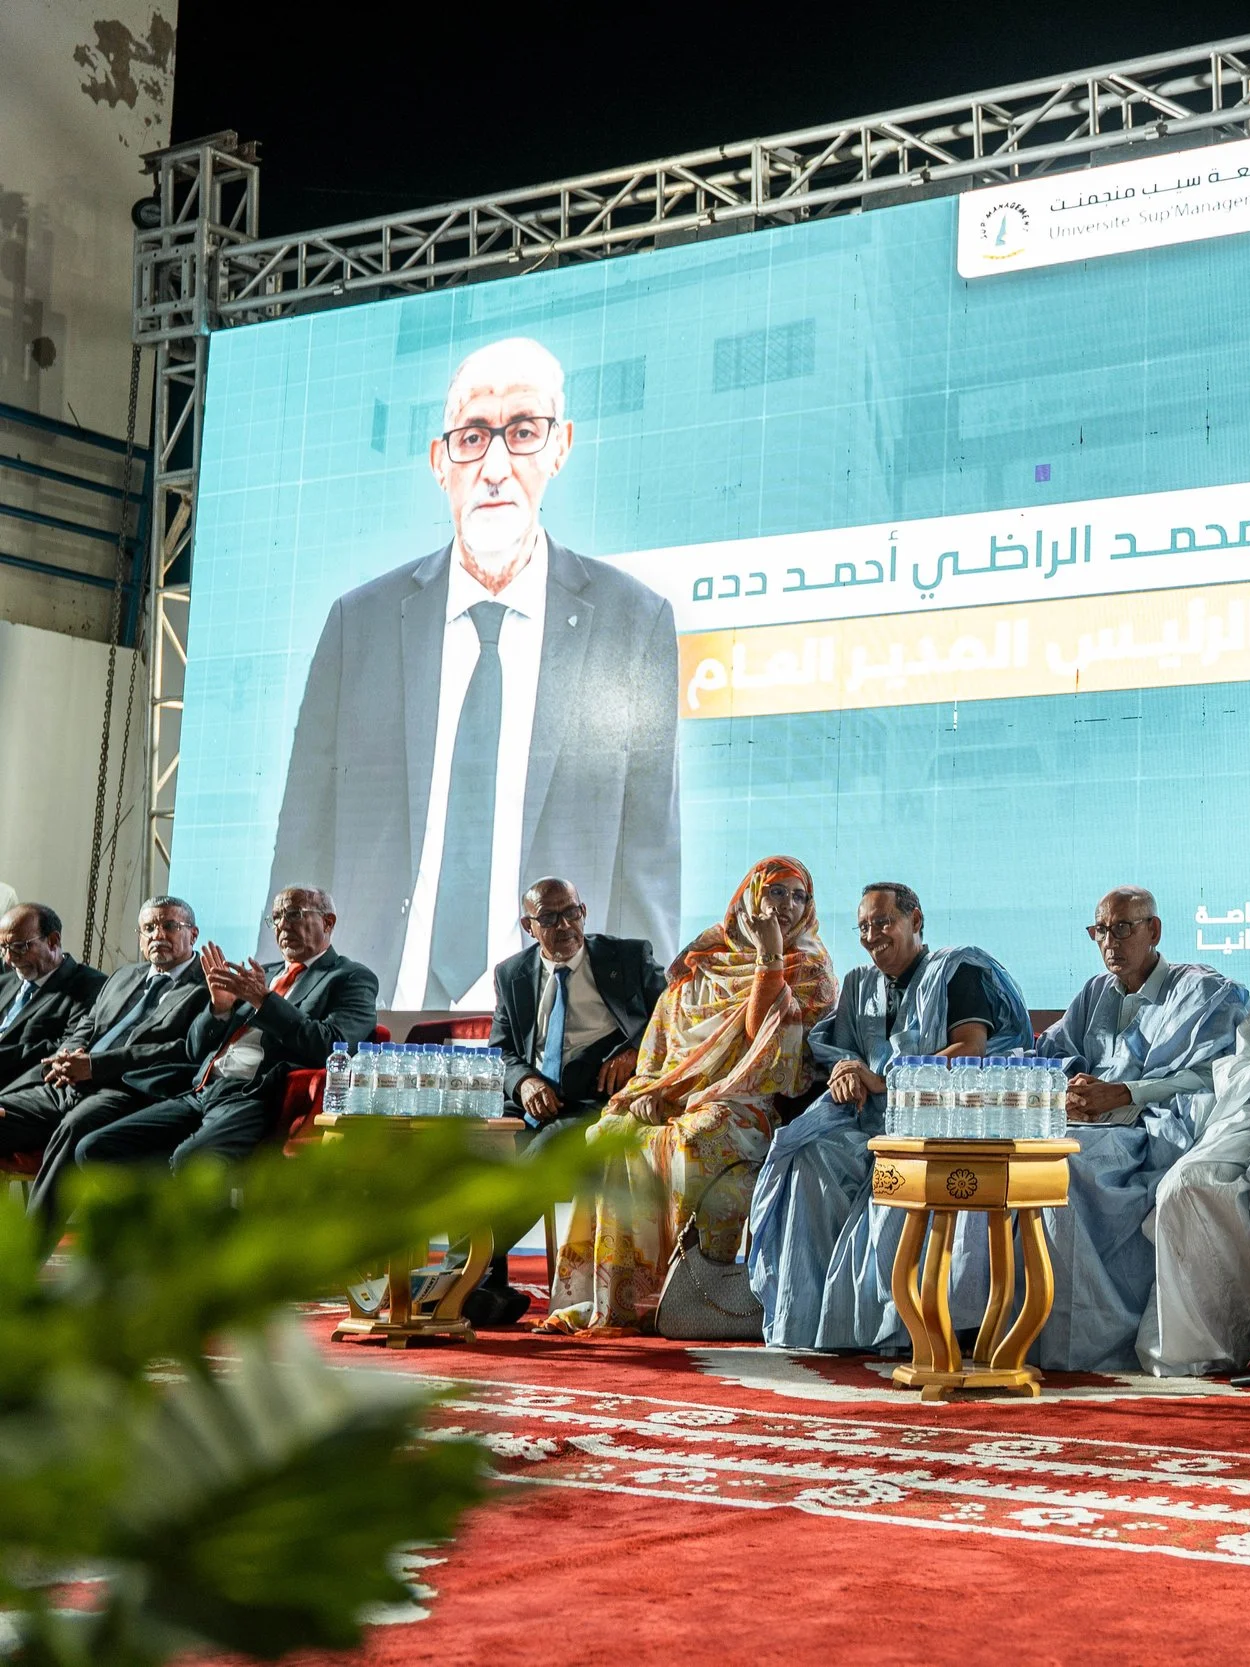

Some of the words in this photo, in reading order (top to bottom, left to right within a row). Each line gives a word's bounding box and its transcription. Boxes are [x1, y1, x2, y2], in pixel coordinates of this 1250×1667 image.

[1050, 185, 1135, 212] منجمنت
[1142, 175, 1200, 199] سيب
[693, 573, 768, 602] دده
[783, 530, 899, 593] أحمد
[913, 525, 1091, 601] الراظي
[687, 637, 835, 709] العام
[847, 620, 1029, 690] المدير
